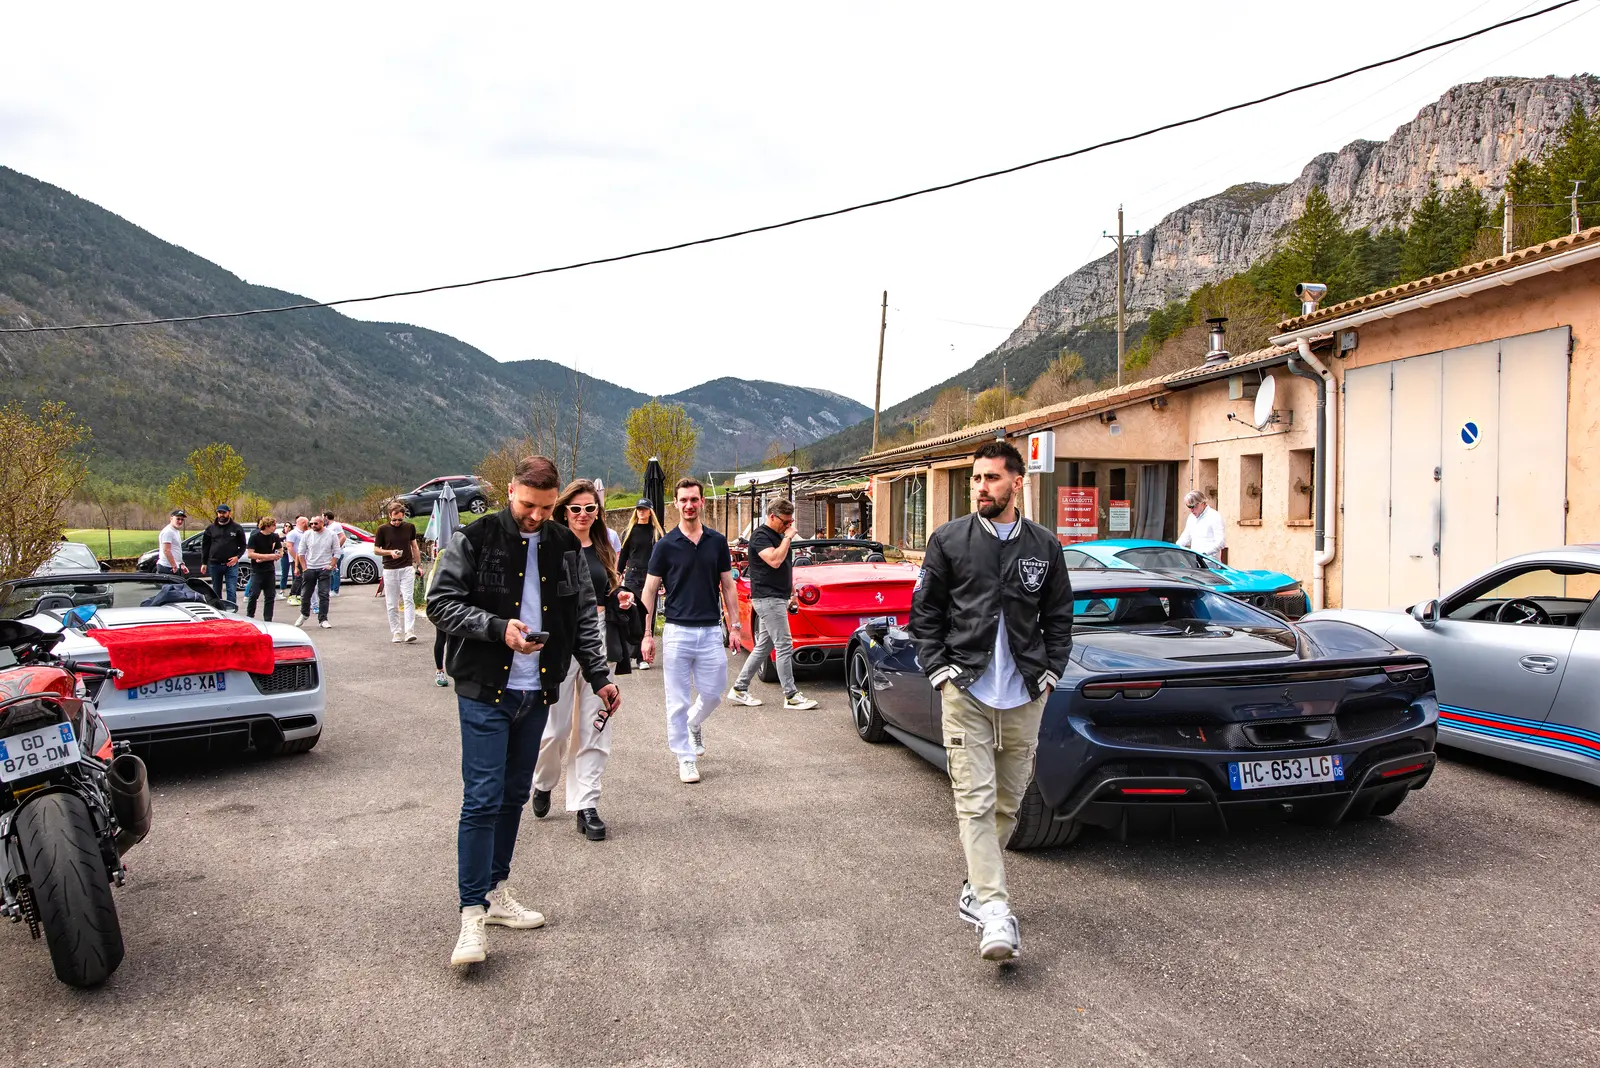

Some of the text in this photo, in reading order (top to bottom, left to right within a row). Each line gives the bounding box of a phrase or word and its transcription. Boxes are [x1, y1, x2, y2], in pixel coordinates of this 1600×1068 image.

[21, 735, 44, 751] GD
[62, 732, 72, 741] 13
[1242, 756, 1330, 784] HC-653-LG
[1334, 766, 1344, 777] 06
